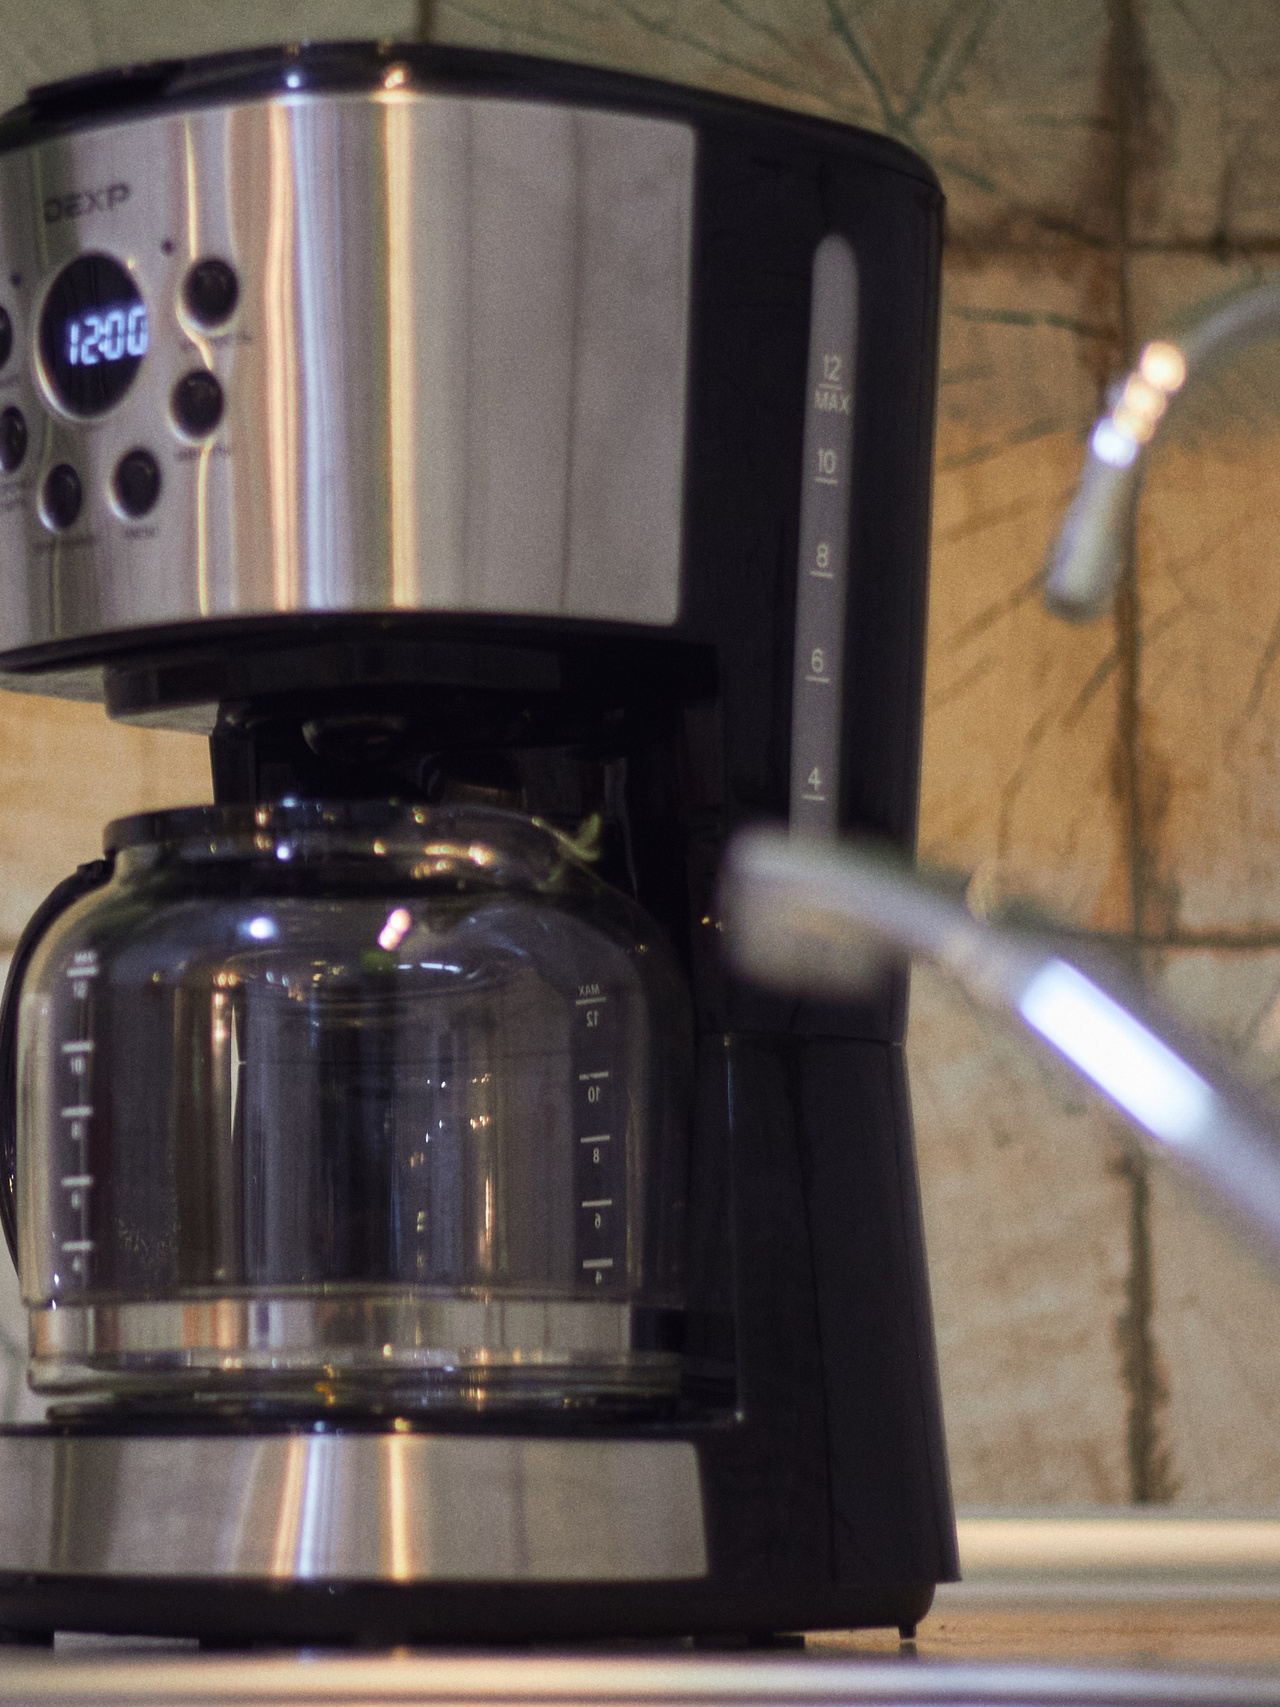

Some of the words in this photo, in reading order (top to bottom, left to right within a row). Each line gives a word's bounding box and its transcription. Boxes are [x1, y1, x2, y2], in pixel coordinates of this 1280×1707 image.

[45, 182, 131, 223] DEXP
[70, 306, 148, 366] 12:00
[825, 356, 842, 381] 12
[815, 391, 851, 415] MAX
[818, 449, 835, 475] 10
[817, 544, 830, 568] 8
[812, 649, 824, 673] 6
[808, 767, 821, 791] 4
